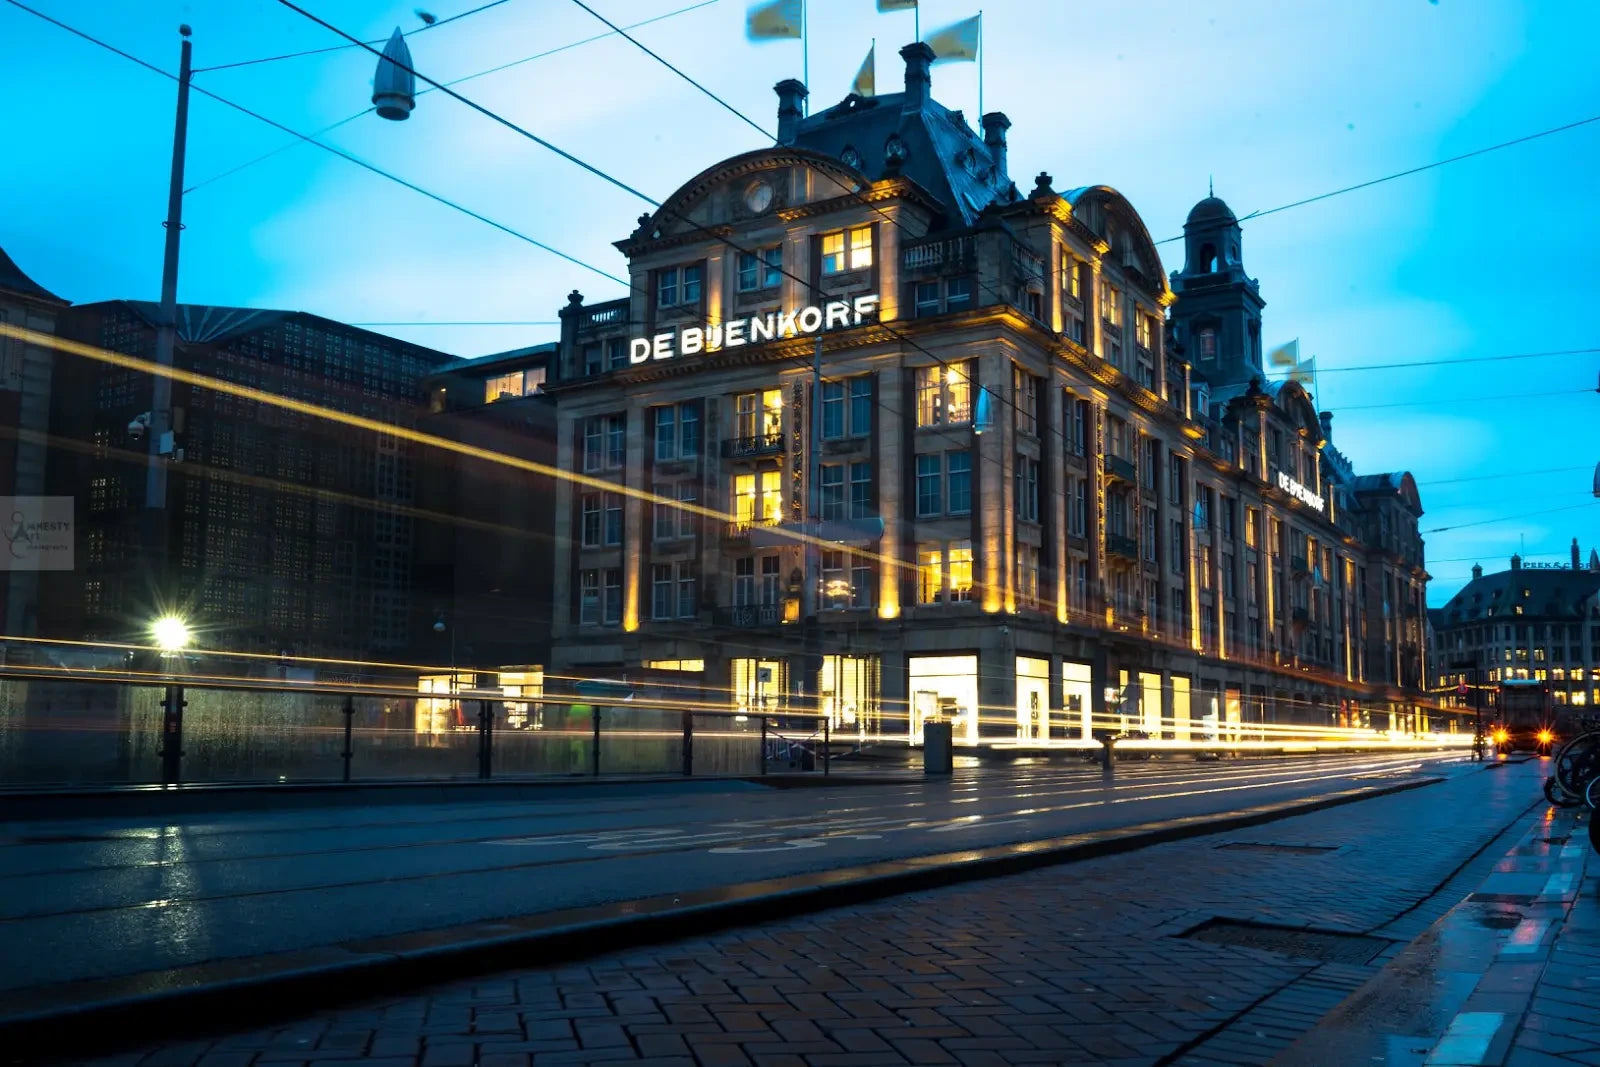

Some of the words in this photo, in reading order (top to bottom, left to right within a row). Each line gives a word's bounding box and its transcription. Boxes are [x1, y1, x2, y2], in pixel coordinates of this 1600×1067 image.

[630, 332, 675, 365] DE
[680, 293, 880, 355] BIJENKORF
[1278, 471, 1290, 493] DE
[480, 828, 883, 854] BUS
